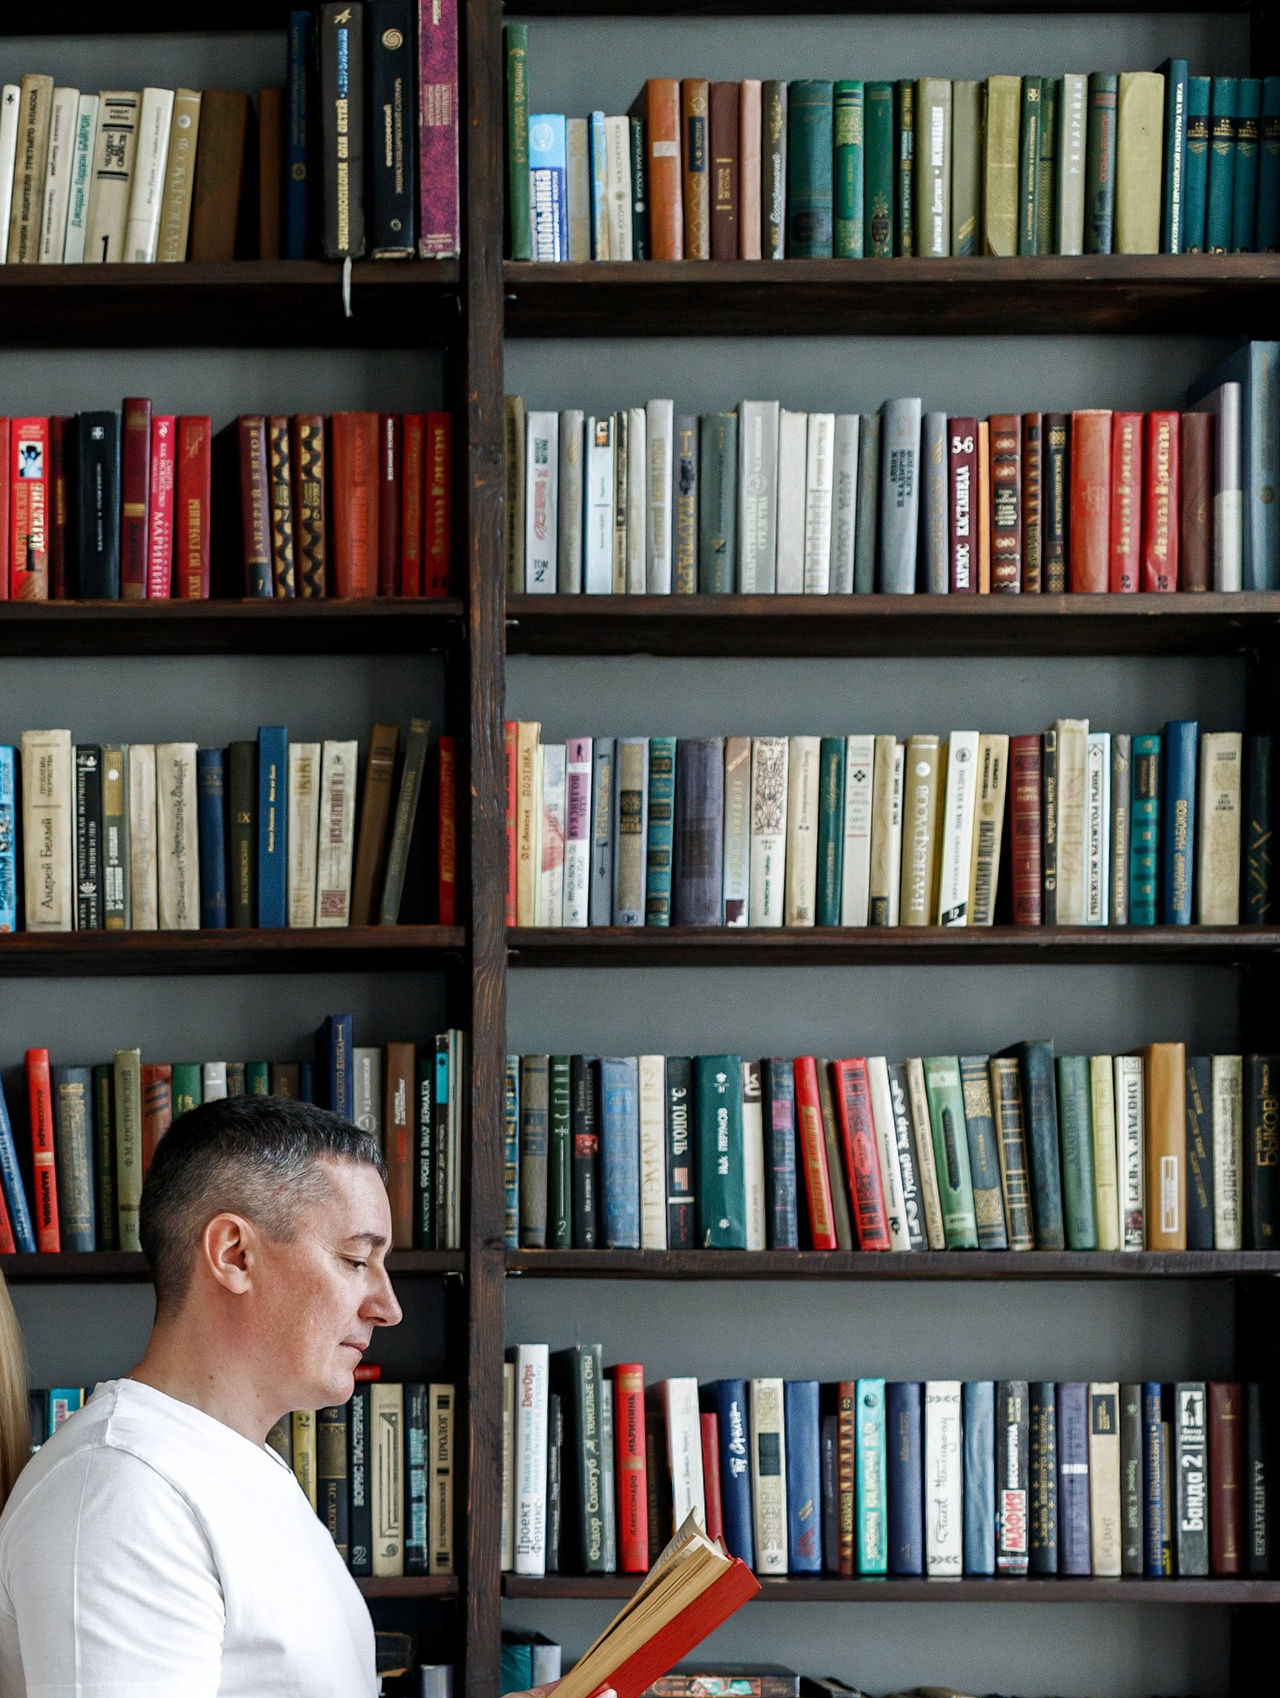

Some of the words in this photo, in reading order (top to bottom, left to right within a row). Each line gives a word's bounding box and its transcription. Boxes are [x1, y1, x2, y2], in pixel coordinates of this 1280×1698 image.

[27, 89, 39, 124] КЛАССА
[335, 99, 349, 133] ДЕТЕЙ
[1176, 83, 1184, 103] ВЕКА
[24, 128, 35, 170] ТРЕТЬЕГО
[77, 115, 91, 151] БАЙРОН
[338, 136, 349, 158] ДЛЯ
[21, 174, 32, 221] ВОДИТЕЛЯ
[338, 162, 349, 250] ЭНЦИКЛОПЕДИЯ
[250, 430, 262, 480] БИТОВ
[29, 483, 45, 551] ДЕТЕКТИВ
[252, 488, 264, 551] АНДРЕЙ
[955, 465, 971, 537] КАСТАНЕДА
[956, 544, 970, 589] КАРЛОС
[39, 757, 47, 795] ПРОБЛЕМЫ
[521, 748, 532, 797] ПОЭТИКА
[1091, 770, 1100, 803] МИРЫ
[569, 775, 581, 838] ПОЛЯНСКАЯ
[1046, 804, 1056, 844] КОРНЕЛИЙ
[1174, 798, 1189, 850] НАБОКОВ
[39, 817, 54, 858] Белый
[1091, 806, 1100, 857] РОДЖЕРА
[1115, 807, 1126, 855] ПОВЕСТИ
[40, 862, 56, 910] Андрей
[1091, 861, 1100, 917] ЖЕЛЯЗНЫ
[1115, 854, 1125, 917] ЭСТОНСКИЕ
[1173, 851, 1188, 911] ВЛАДИМИР
[336, 1041, 347, 1070] ЯЗЫКА
[336, 1072, 347, 1114] РУССКОГО
[421, 1079, 431, 1124] ВЕРМАХТА
[584, 1067, 595, 1125] Полякова
[673, 1087, 687, 1102] Э.
[422, 1125, 431, 1148] ТЫЛУ
[672, 1103, 687, 1156] ТОПОЛЬ
[717, 1107, 729, 1152] ПЕРУМОВ
[896, 1116, 911, 1149] Эмар
[421, 1157, 431, 1188] ФРОНТ
[717, 1155, 729, 1175] Ник
[899, 1153, 917, 1199] Густав
[40, 1170, 51, 1228] МАРИНИНА
[521, 1364, 536, 1408] DevOps
[583, 1355, 595, 1380] СНЫ
[352, 1395, 366, 1464] ПАСТЕРНАК
[585, 1383, 597, 1436] ТЯЖЕЛЫЕ
[627, 1393, 637, 1455] МАРИНИНА
[437, 1414, 448, 1462] ПРОЛОГ
[932, 1416, 957, 1488] Hemingway
[1007, 1424, 1019, 1490] БЕССМЕРТНА
[1182, 1454, 1204, 1469] 2
[353, 1465, 366, 1507] БОРИС
[522, 1464, 531, 1495] Роман
[586, 1459, 600, 1513] Сологуб
[1183, 1471, 1206, 1532] Банда
[517, 1502, 532, 1556] Проект
[628, 1474, 638, 1537] Александра
[934, 1498, 949, 1544] Ernest
[1004, 1490, 1025, 1550] МАФИЯ
[1254, 1486, 1266, 1556] ИГНАТЬЕВ
[588, 1517, 602, 1561] Федор
